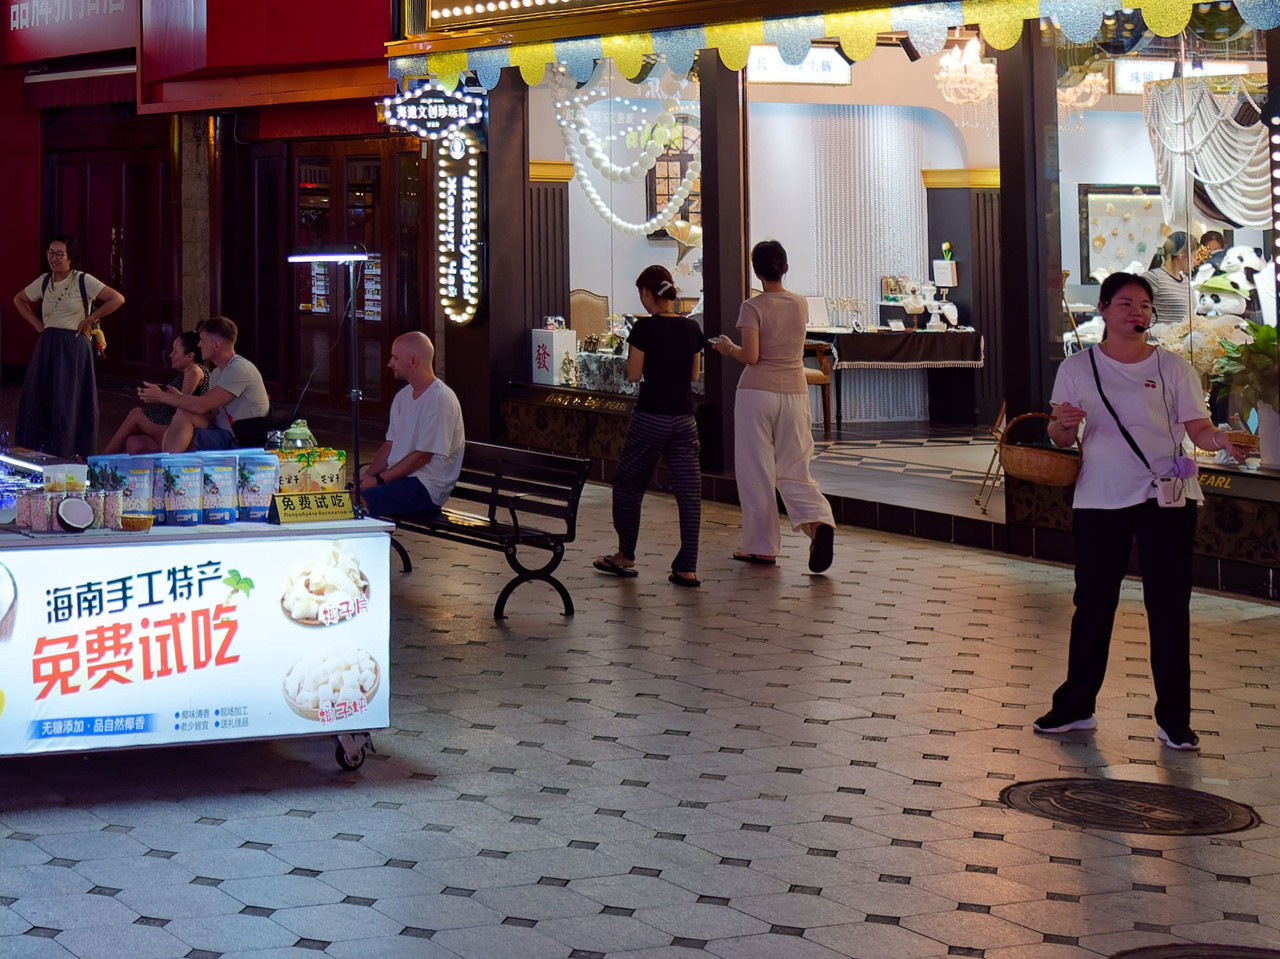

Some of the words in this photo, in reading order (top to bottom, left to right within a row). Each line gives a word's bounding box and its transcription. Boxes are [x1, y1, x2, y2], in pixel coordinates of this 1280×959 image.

[535, 343, 551, 372] 發
[604, 401, 628, 411] PEARL
[282, 494, 345, 511] 免费试吃
[46, 560, 222, 624] 海南手工特产
[322, 594, 369, 624] 椰子片
[32, 604, 241, 702] 免费试吃
[181, 708, 210, 719] 椰味清香
[220, 706, 249, 717] 现场加工
[180, 720, 210, 731] 老少皆宜
[220, 718, 249, 729] 送礼佳品
